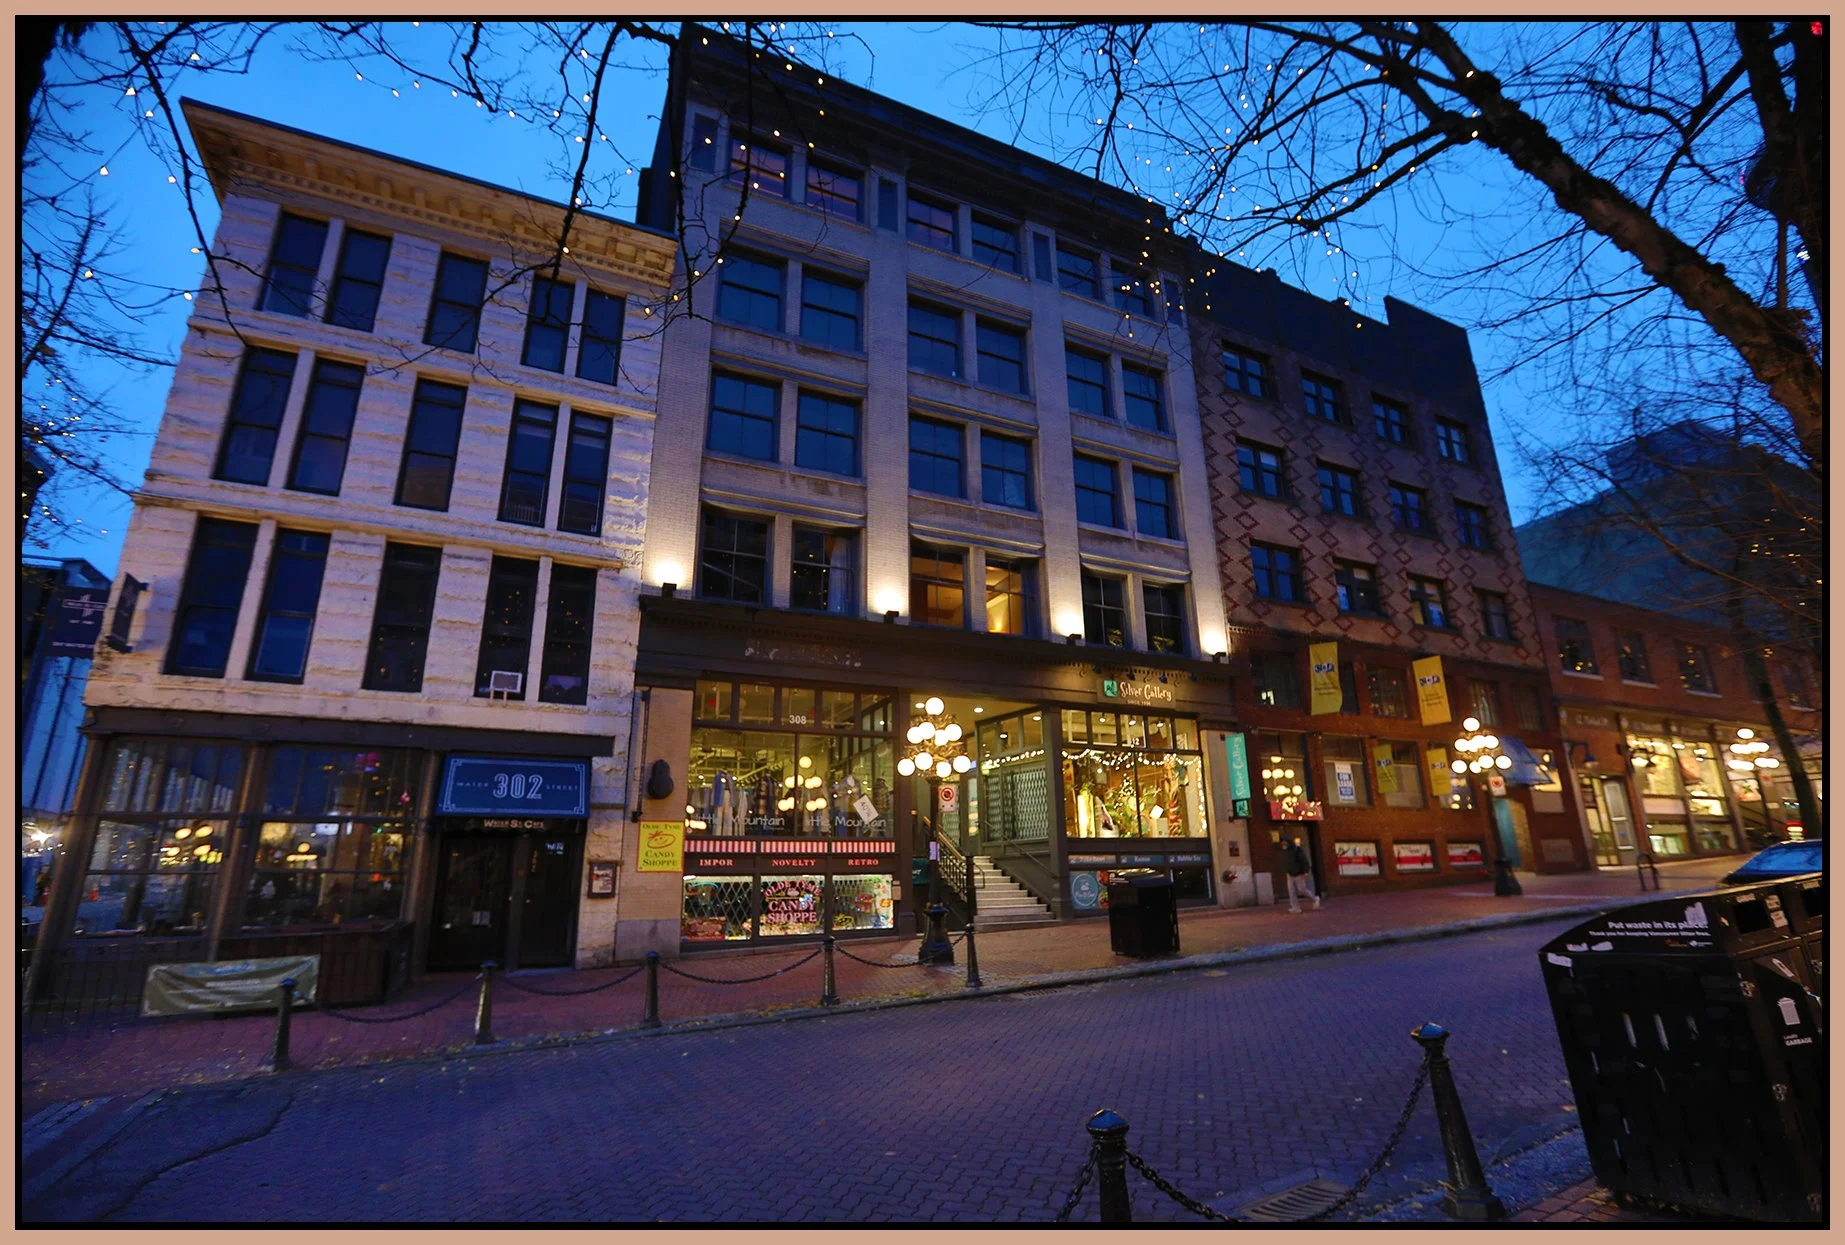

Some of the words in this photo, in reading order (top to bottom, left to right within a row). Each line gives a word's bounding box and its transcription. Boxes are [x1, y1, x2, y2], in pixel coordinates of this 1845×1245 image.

[1120, 681, 1142, 697] Silver
[1144, 684, 1172, 702] Gallery
[789, 715, 807, 725] 308
[492, 773, 544, 800] 302
[834, 815, 887, 829] Mounain
[765, 880, 791, 896] OLDE
[795, 880, 822, 896] TYME
[768, 900, 816, 911] CANDY
[767, 911, 817, 924] SHOPPE
[1608, 921, 1624, 929] Put
[1653, 921, 1663, 929] in
[1664, 921, 1677, 929] its
